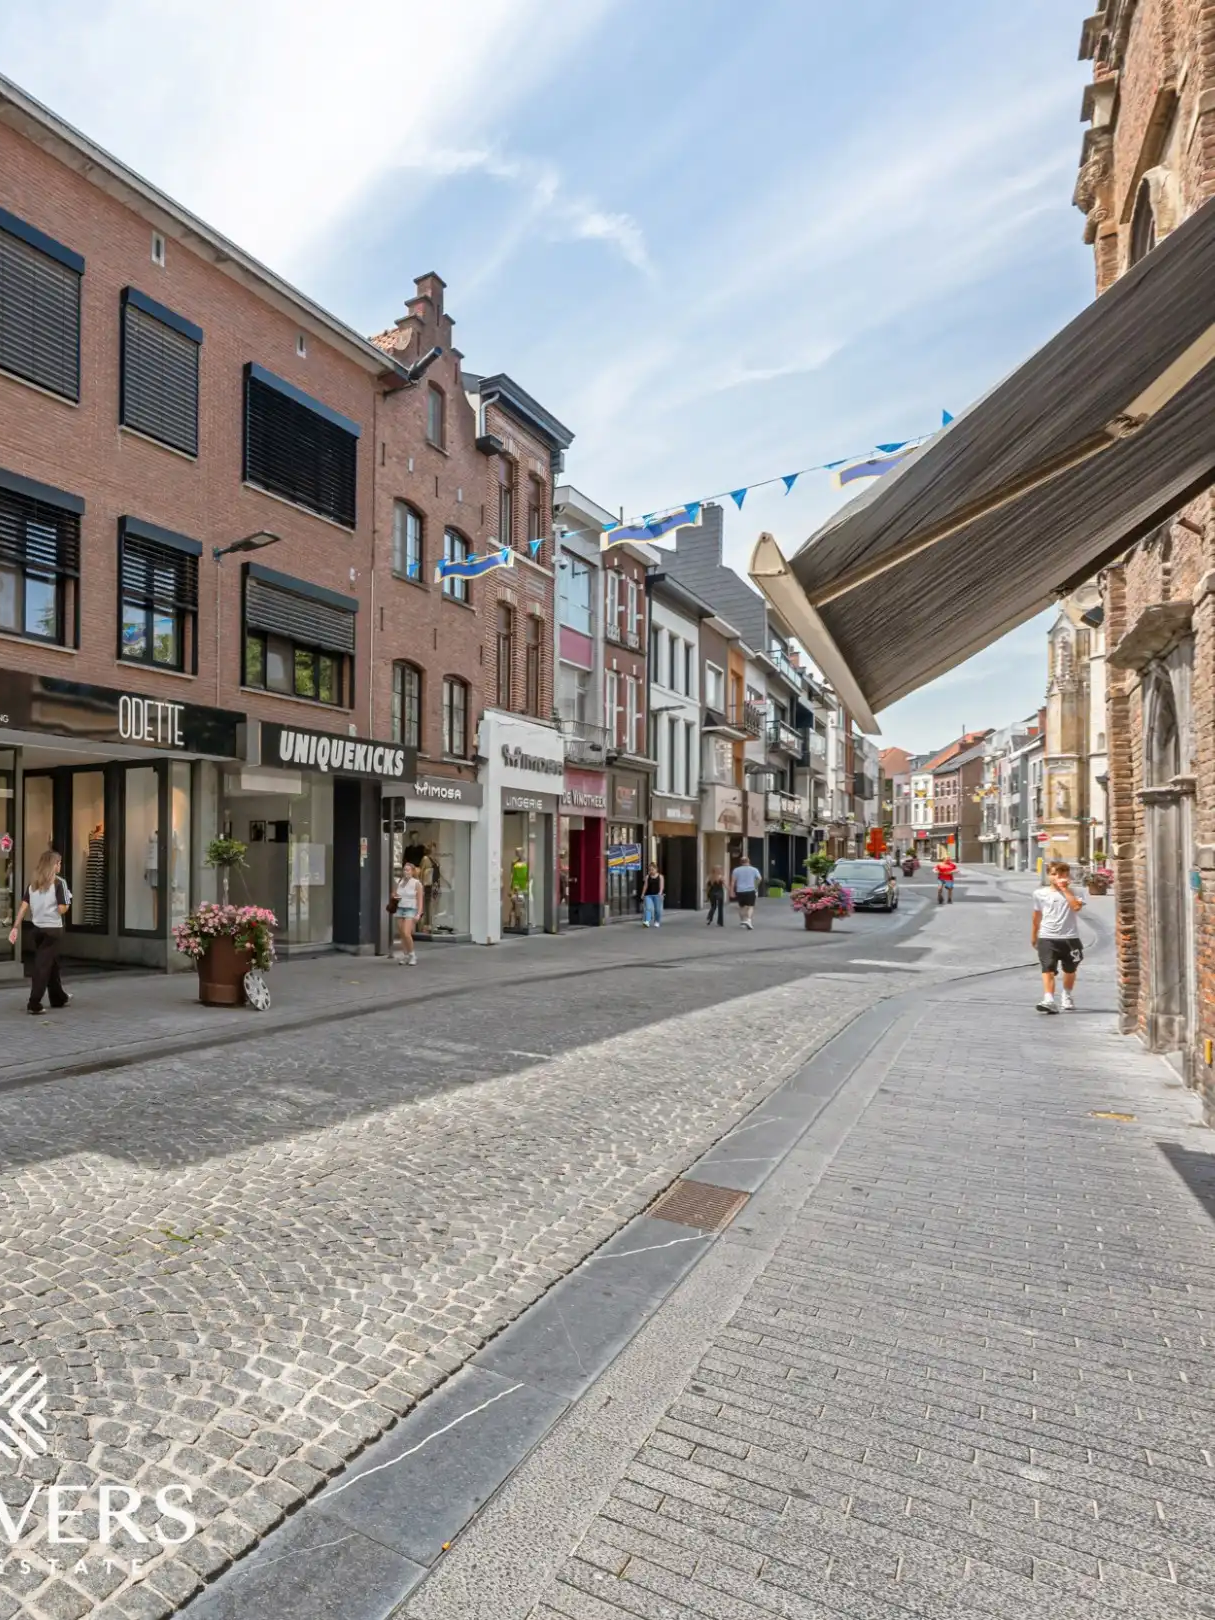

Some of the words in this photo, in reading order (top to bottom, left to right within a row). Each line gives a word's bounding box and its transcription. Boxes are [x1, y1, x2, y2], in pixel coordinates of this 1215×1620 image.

[118, 695, 185, 746] ODETTE
[279, 730, 405, 777] UNIQUEKICKS
[506, 795, 543, 810] LINGERIE
